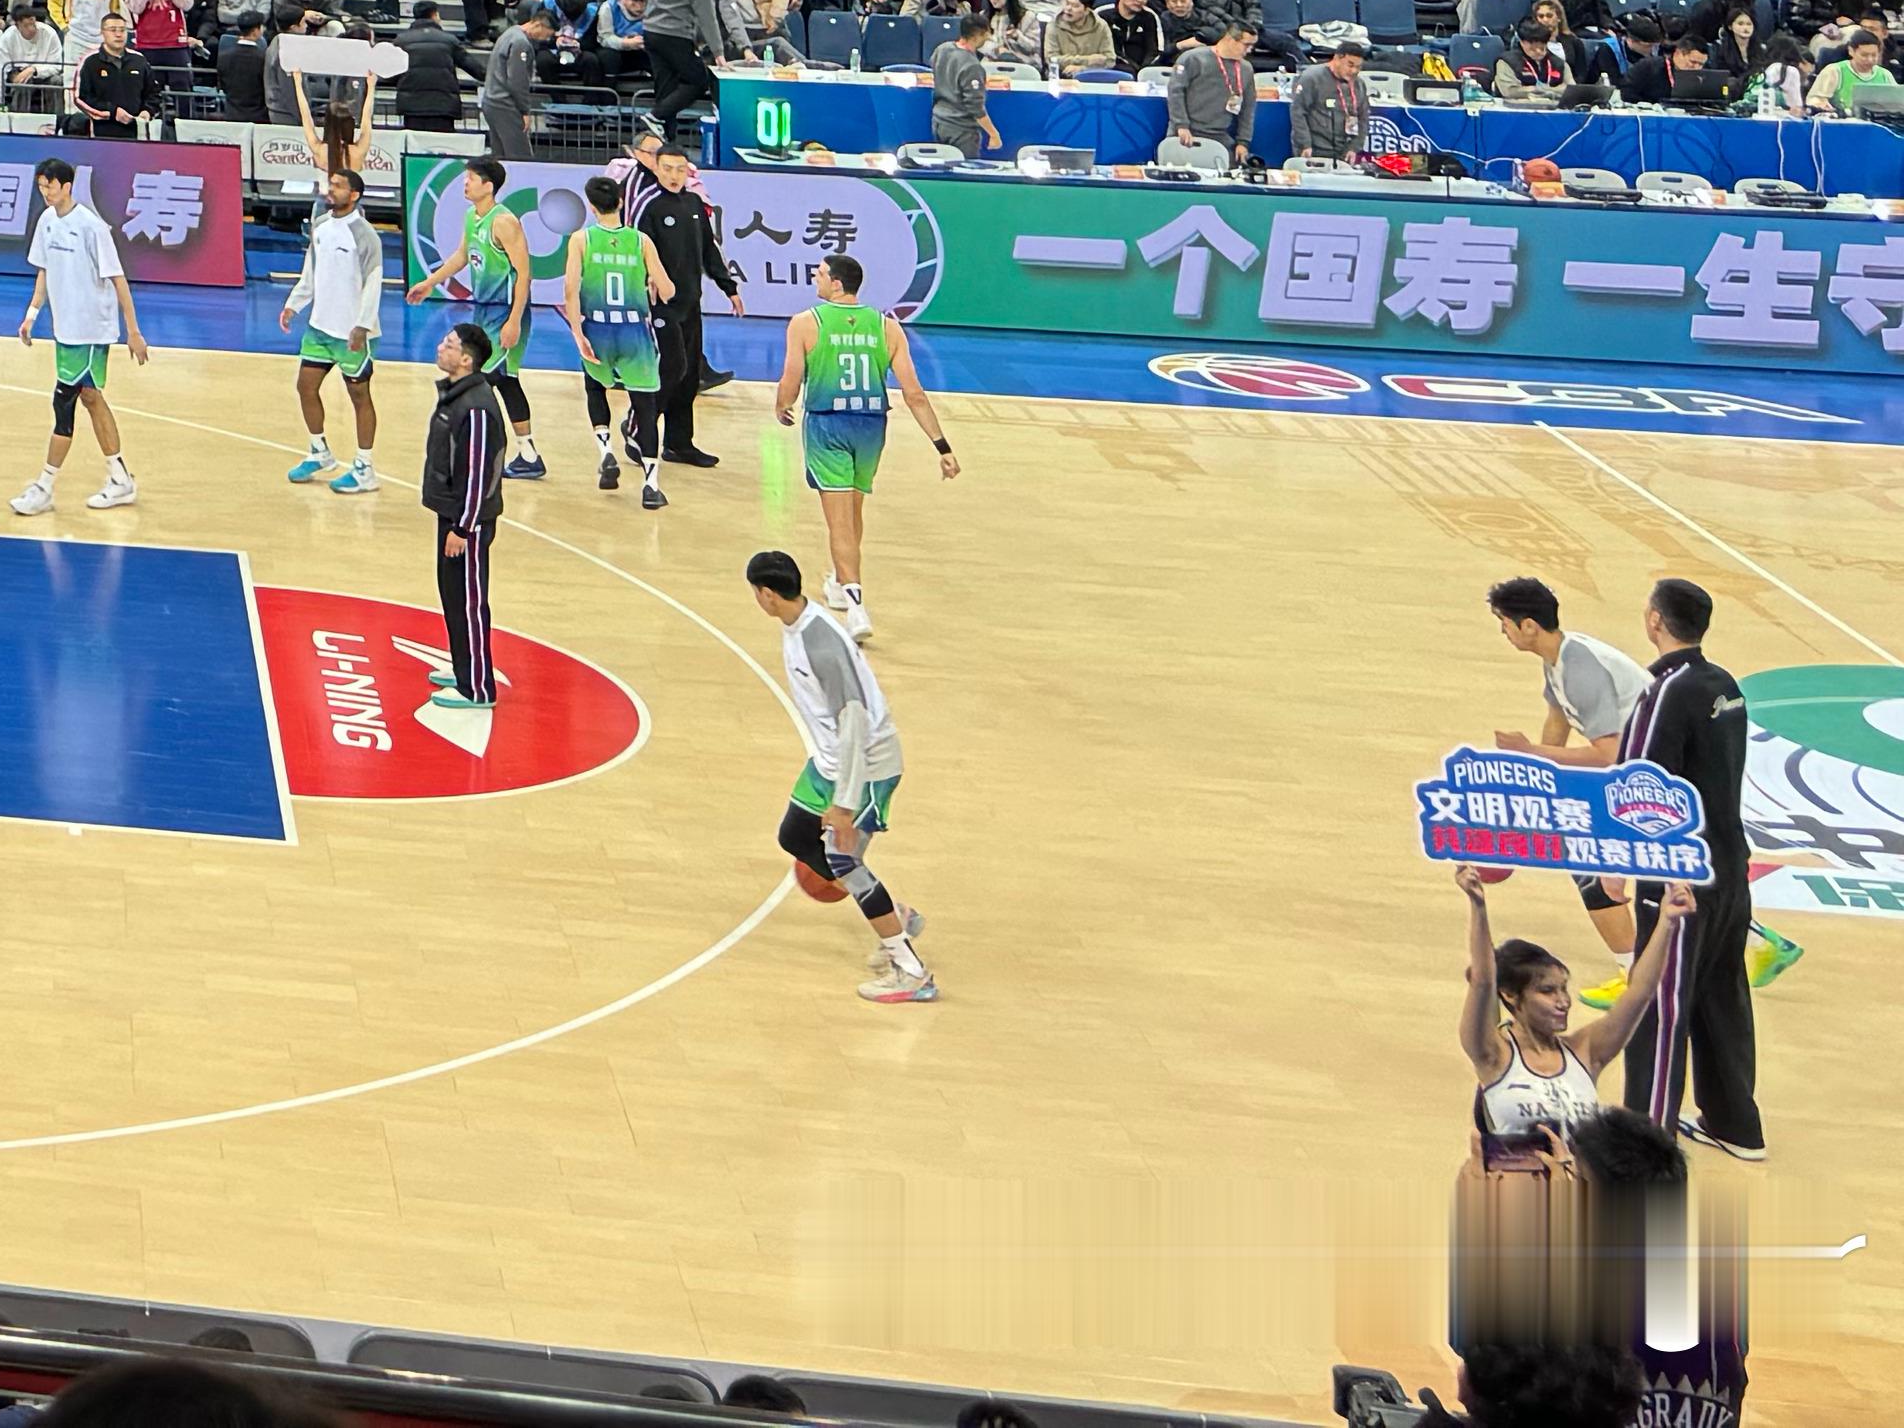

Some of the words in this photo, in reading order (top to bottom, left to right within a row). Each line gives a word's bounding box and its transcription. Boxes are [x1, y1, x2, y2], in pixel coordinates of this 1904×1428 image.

[606, 272, 625, 306] 0
[1012, 204, 1519, 335] 一个国寿
[839, 353, 871, 391] 31
[1382, 373, 1864, 425] CBA
[311, 629, 393, 752] LI-NING
[1454, 759, 1556, 795] PIONEERS
[1425, 787, 1591, 831] 文明观赛
[1608, 782, 1689, 821] PIONEERS
